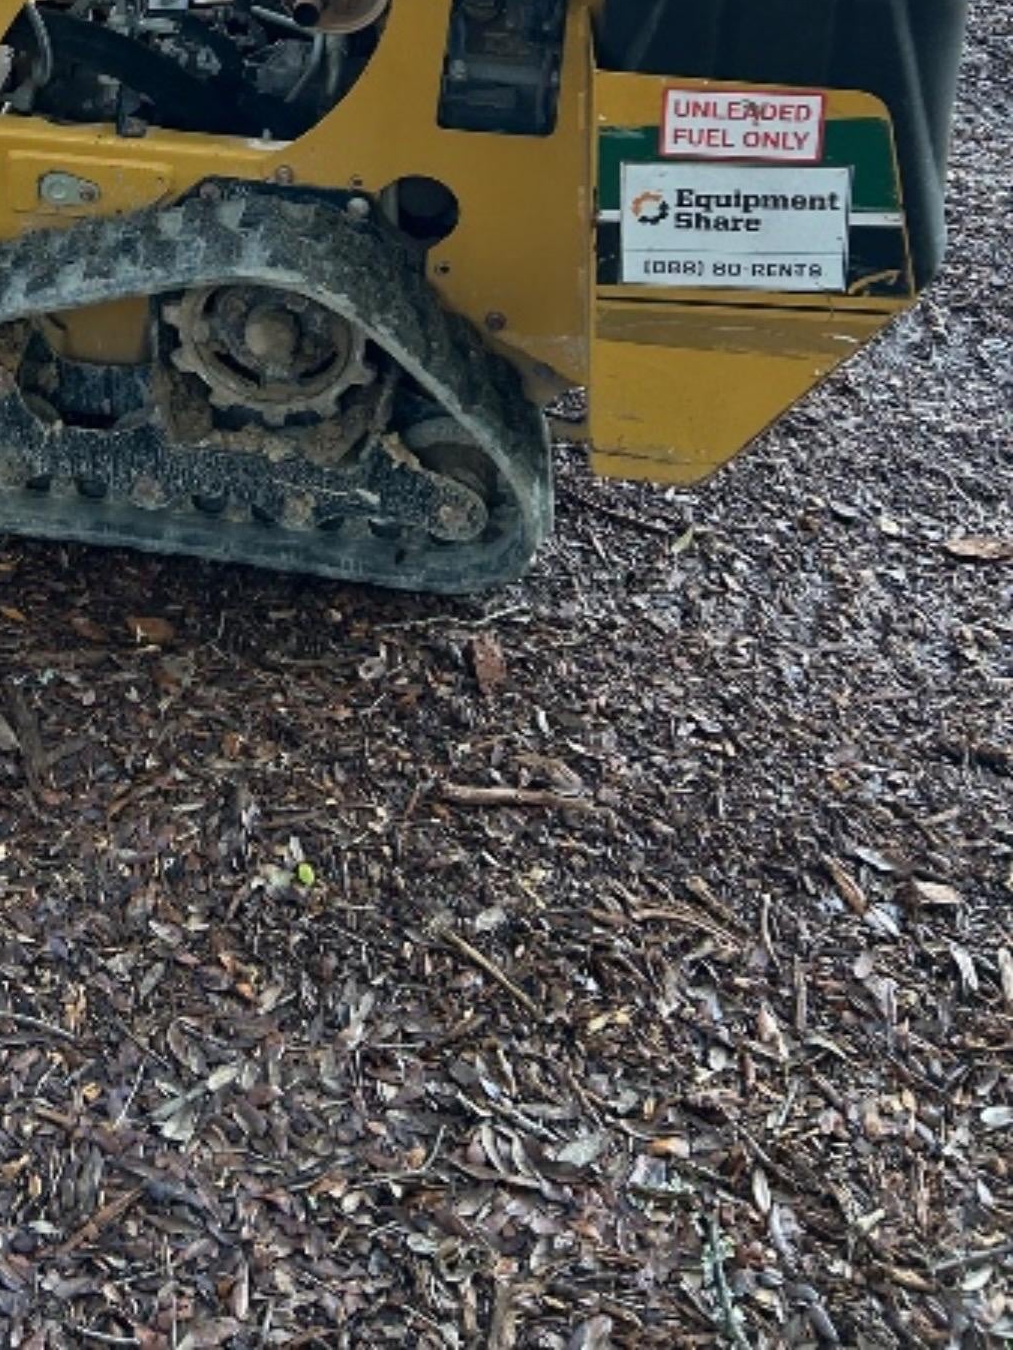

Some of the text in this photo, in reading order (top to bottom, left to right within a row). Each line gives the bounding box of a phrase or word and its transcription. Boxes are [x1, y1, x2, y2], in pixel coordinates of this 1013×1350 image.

[673, 100, 812, 123] UNLEADED
[673, 128, 810, 150] FUEL ONLY
[674, 188, 841, 213] Equipment
[674, 211, 762, 232] Share
